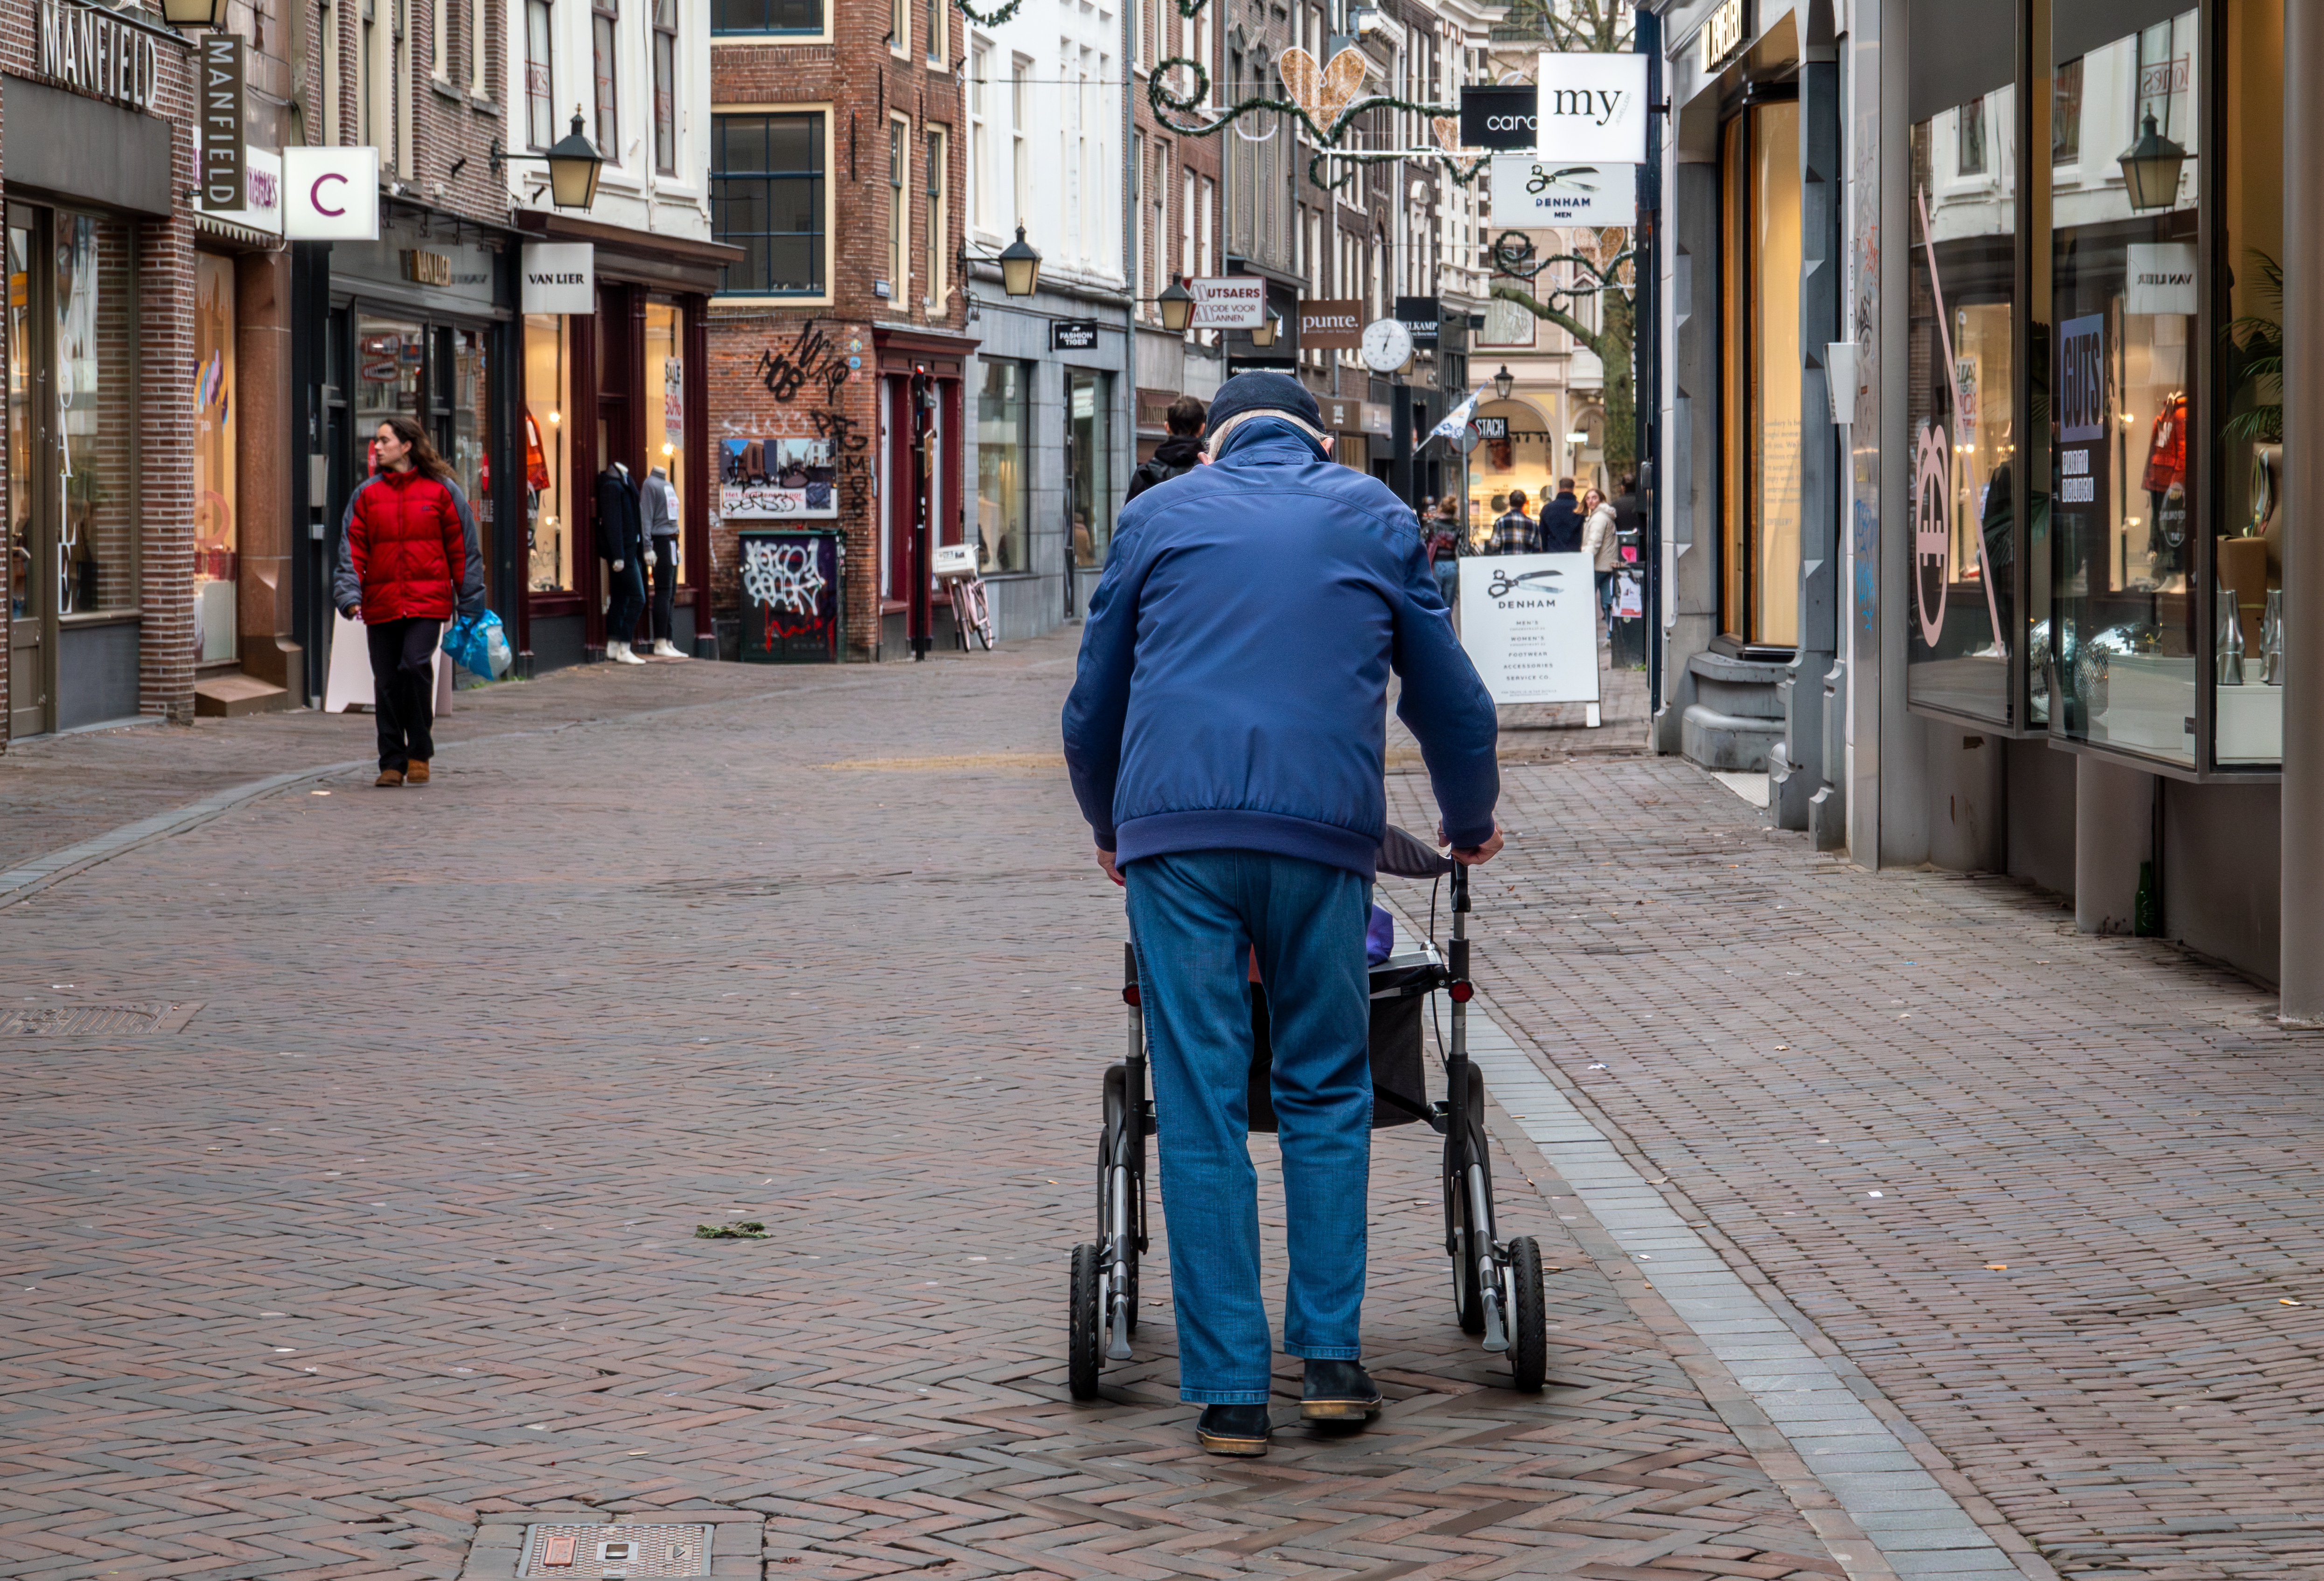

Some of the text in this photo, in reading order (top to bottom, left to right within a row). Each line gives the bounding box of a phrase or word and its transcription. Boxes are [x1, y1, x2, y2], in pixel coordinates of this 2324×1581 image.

[42, 0, 156, 108] MANFIELD
[1553, 90, 1623, 126] my
[208, 41, 235, 203] MANFIELD
[310, 173, 348, 217] C
[1536, 198, 1591, 207] DENHAM
[529, 273, 584, 285] VAN LIER
[1232, 304, 1256, 313] VOOR
[2063, 332, 2100, 428] GUTS
[1475, 419, 1504, 436] STACH
[1498, 599, 1556, 609] DENHAM
